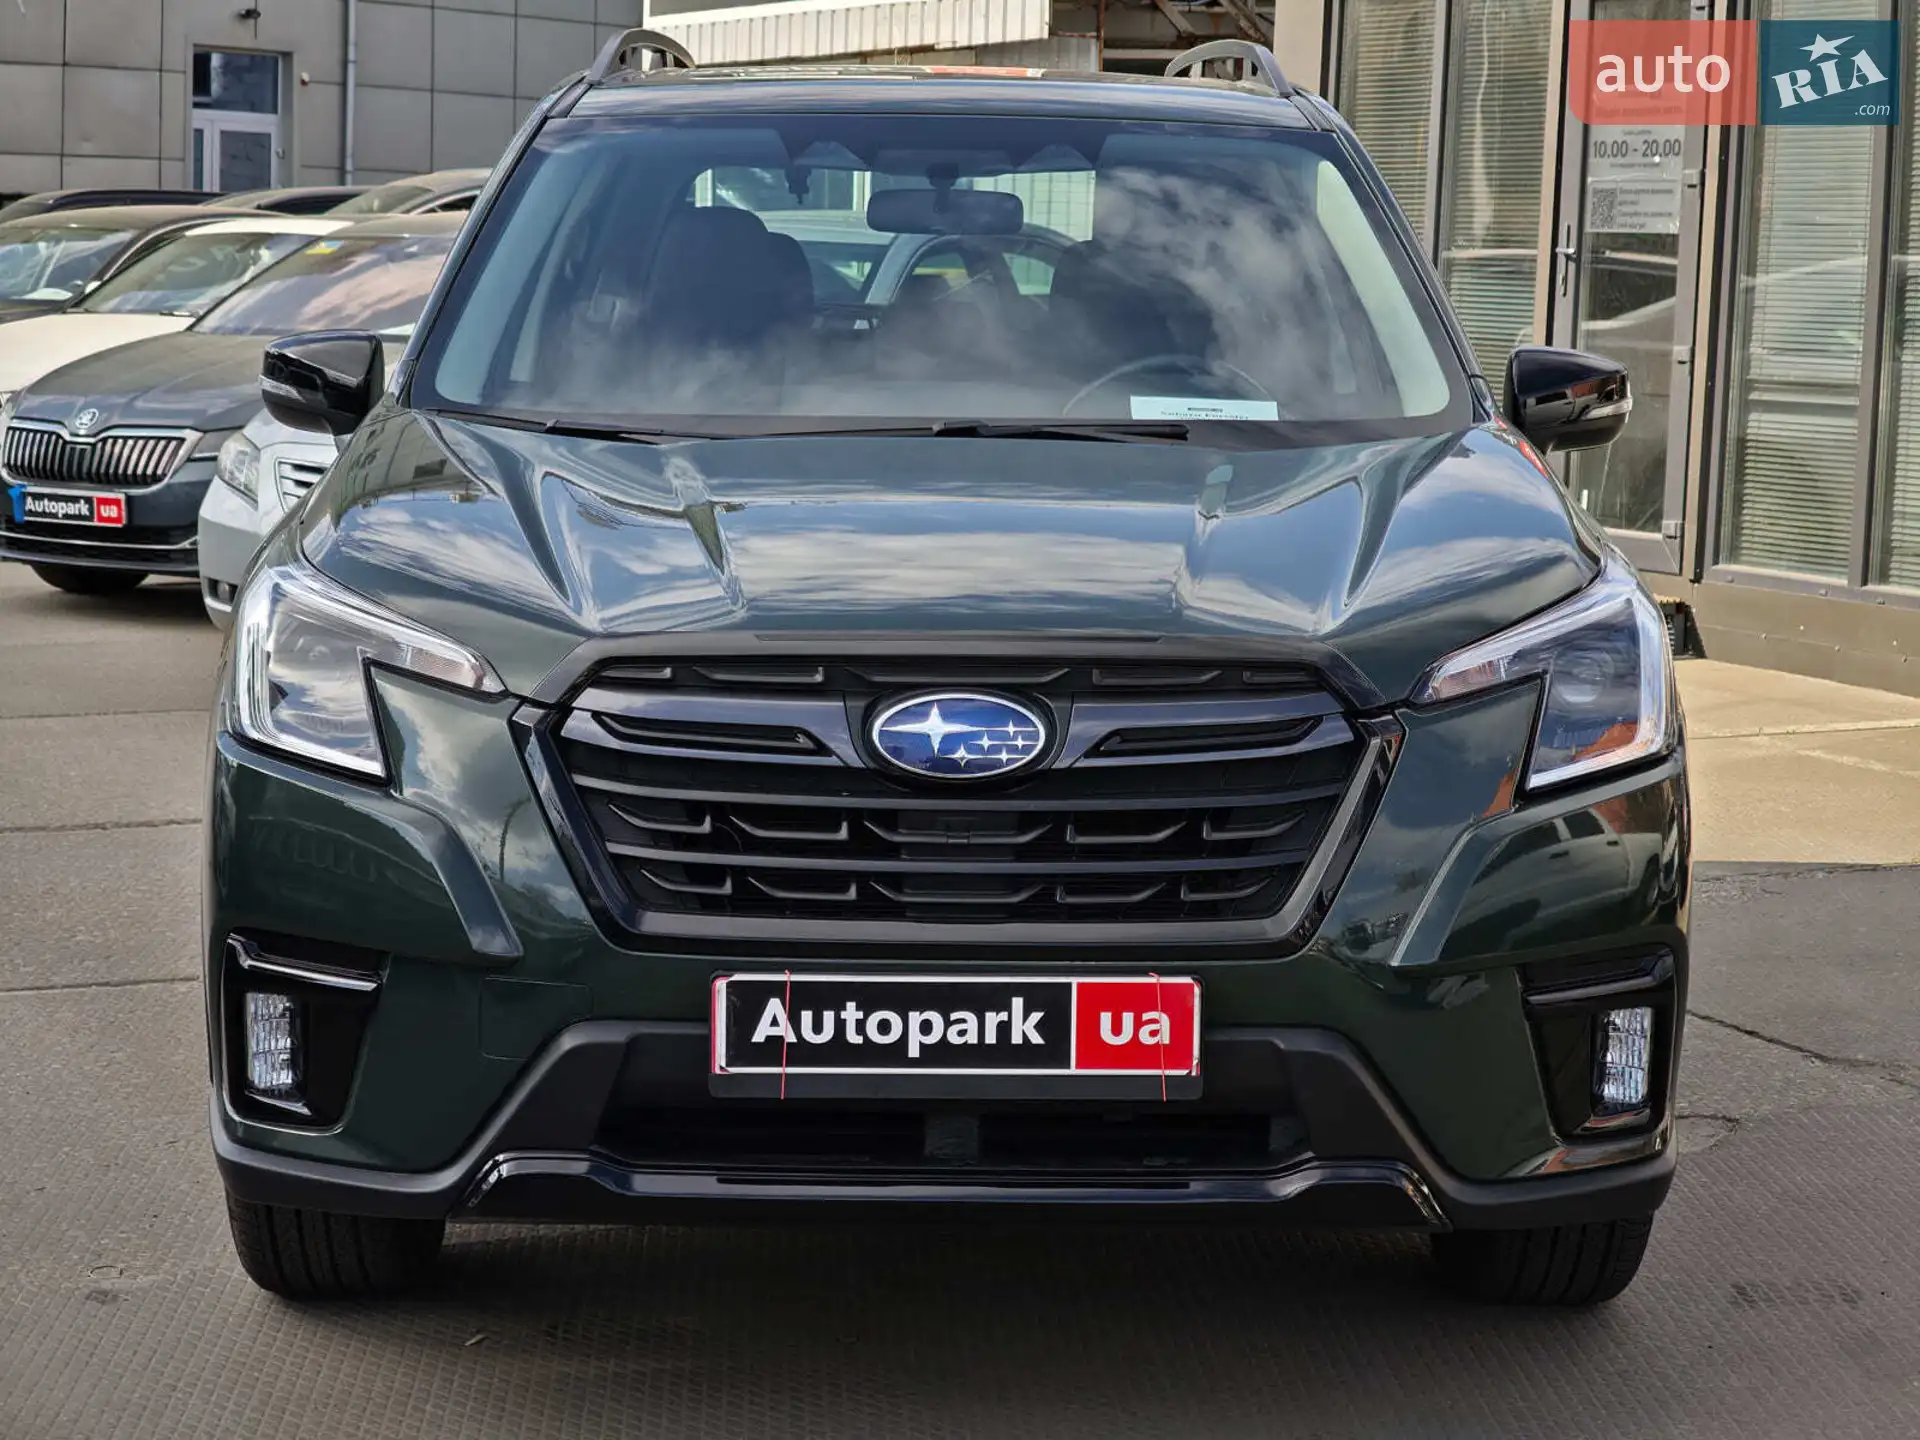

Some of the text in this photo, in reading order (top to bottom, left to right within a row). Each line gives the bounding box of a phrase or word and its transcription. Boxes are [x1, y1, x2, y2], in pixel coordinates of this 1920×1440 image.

[1593, 139, 1629, 159] 10.00
[1642, 138, 1682, 158] 20.00
[25, 497, 119, 518] Autopark ua
[751, 997, 1171, 1058] Autopark ua
